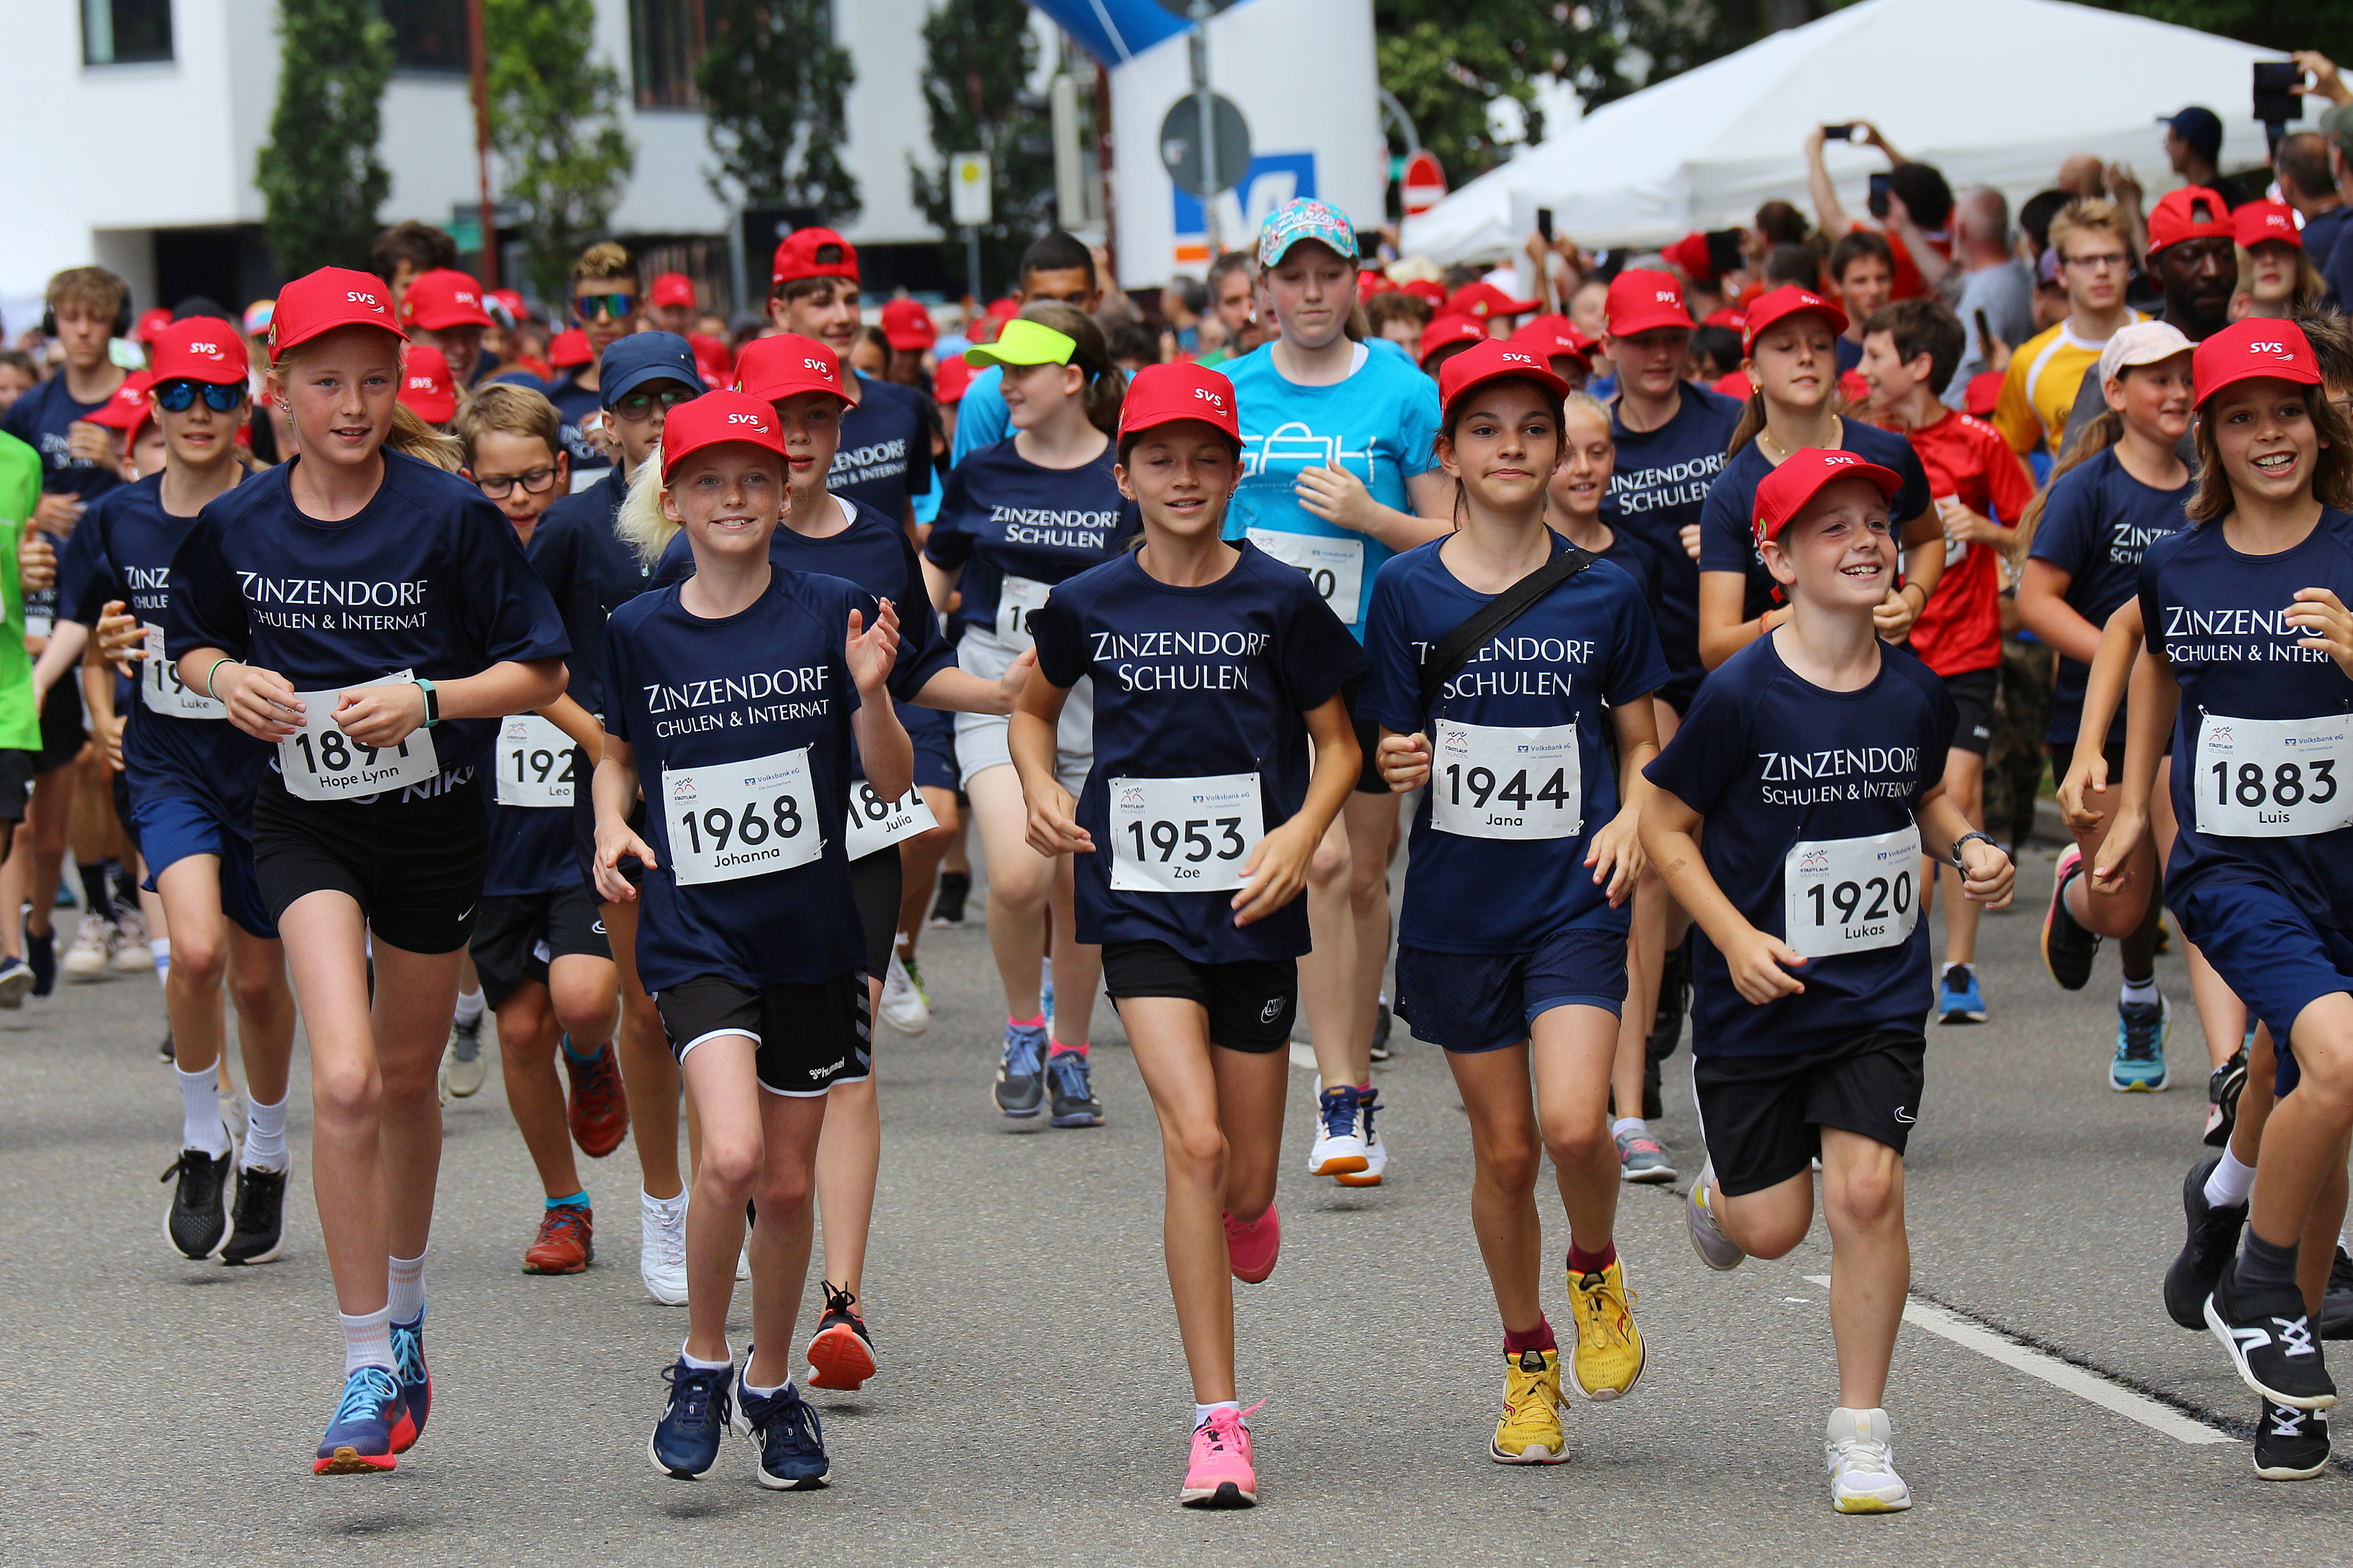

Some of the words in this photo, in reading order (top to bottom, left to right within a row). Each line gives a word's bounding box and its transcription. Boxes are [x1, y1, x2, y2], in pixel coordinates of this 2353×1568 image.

[346, 291, 376, 305] SVS
[189, 342, 218, 354] SVS
[2249, 342, 2284, 353] SVS
[804, 358, 828, 373] SVS
[1501, 352, 1532, 363] SVS
[409, 376, 433, 389] SVS
[1194, 388, 1222, 406] SVS
[728, 413, 759, 425] SVS
[1824, 456, 1855, 466] SVS
[1605, 452, 1727, 496] INZENDORF
[990, 505, 1121, 528] ZINZENDORF
[1004, 523, 1104, 549] SCHULEN
[2112, 523, 2176, 547] ZINZ
[236, 571, 428, 606] ZINZENDORF
[1294, 566, 1336, 599] 0
[134, 594, 169, 609] CHULE
[253, 608, 315, 629] HULEN
[322, 615, 335, 629] &
[342, 612, 427, 630] INTERNAT
[1090, 631, 1270, 662] ZINZENDORF
[1412, 637, 1595, 664] ZENDORF
[2166, 643, 2242, 662] SCHULEN
[2248, 645, 2262, 661] &
[1118, 663, 1248, 692] SCHULEN
[1444, 671, 1572, 699] SCHULEN
[644, 666, 828, 713] ZINZENDORF
[181, 698, 209, 709] Luke
[653, 713, 724, 738] CHULEN
[729, 711, 743, 728] &
[748, 699, 829, 724] INTERNAT
[2298, 735, 2333, 744] Volksbank
[1445, 745, 1468, 753] STADTLAUF
[1445, 750, 1468, 759] VILLINGEN
[319, 773, 358, 789] Hope
[362, 766, 399, 784] Lynn
[757, 770, 791, 783] Volksbank
[2212, 759, 2337, 808] 1883
[549, 786, 571, 796] Leo
[1447, 763, 1569, 810] 1944
[1762, 785, 1842, 805] SCHULEN
[1847, 783, 1859, 800] &
[1206, 793, 1239, 802] Volksbank
[682, 795, 802, 854] 1968
[885, 815, 912, 833] Julia
[1485, 813, 1523, 826] Jana
[2259, 810, 2291, 823] Luis
[1128, 817, 1245, 862] 1953
[714, 848, 780, 868] Johanna
[1174, 866, 1201, 878] Zoe
[1808, 870, 1911, 926] 1920
[1845, 925, 1885, 939] Lukas
